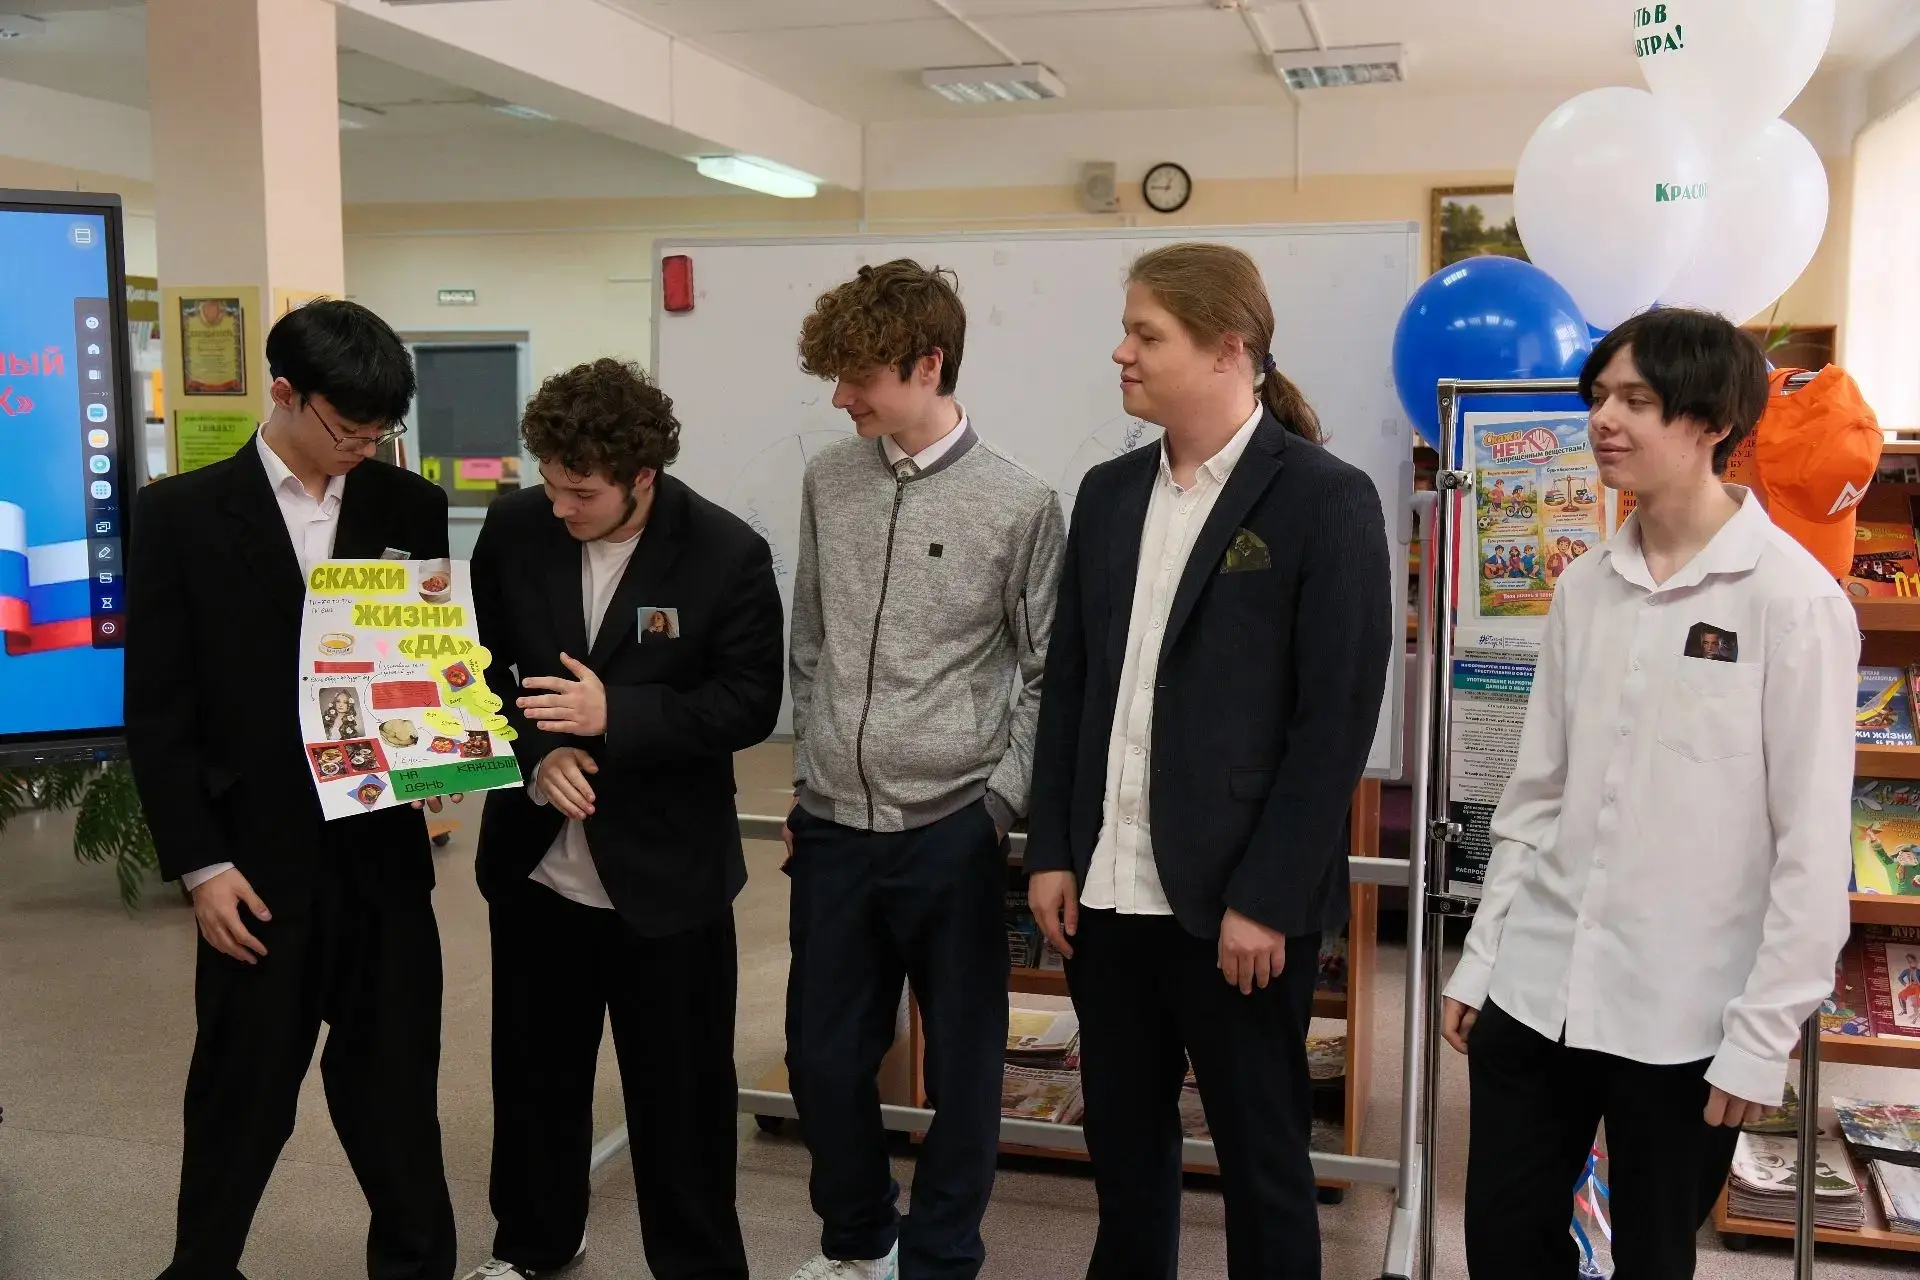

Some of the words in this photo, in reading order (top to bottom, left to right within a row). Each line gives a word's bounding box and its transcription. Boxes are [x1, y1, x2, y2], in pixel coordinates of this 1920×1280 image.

[1655, 4, 1667, 24] В
[1484, 431, 1522, 446] Скажи
[1493, 441, 1526, 459] НЕТ
[1545, 442, 1587, 457] веществам!
[311, 568, 405, 589] СКАЖИ
[354, 604, 463, 627] ЖИЗНИ
[398, 634, 474, 659] «ДА»
[1872, 732, 1913, 740] ЖИЗНИ
[400, 770, 419, 780] НА
